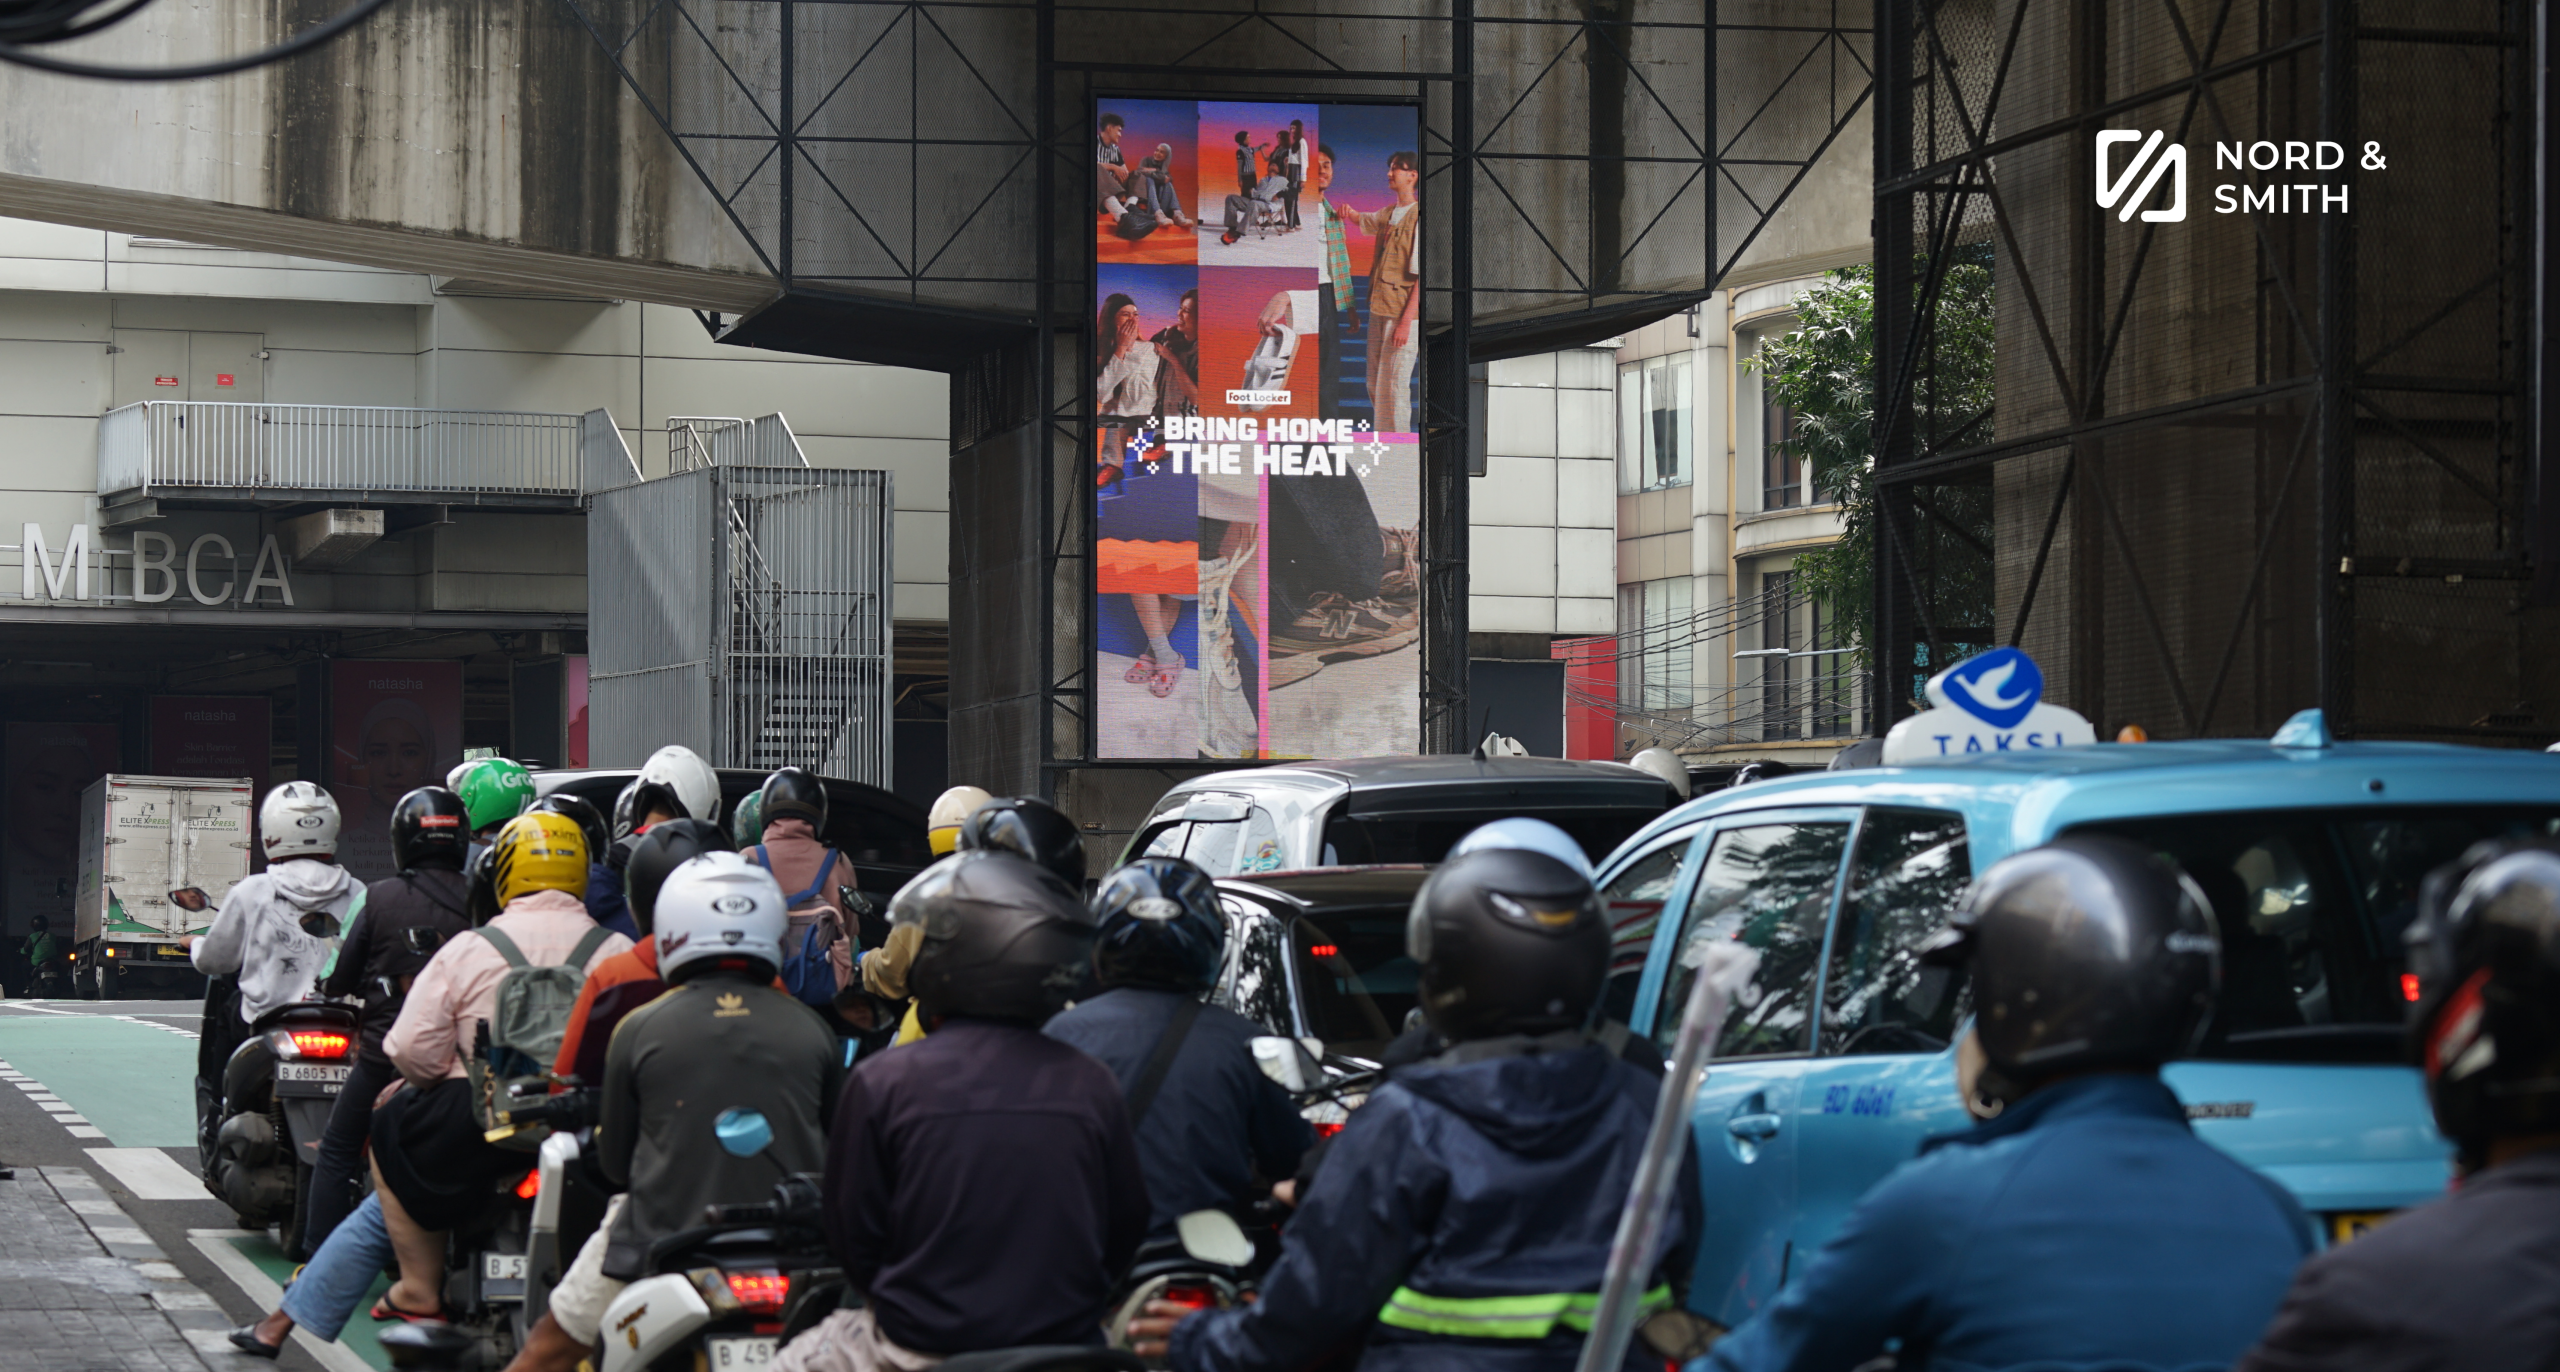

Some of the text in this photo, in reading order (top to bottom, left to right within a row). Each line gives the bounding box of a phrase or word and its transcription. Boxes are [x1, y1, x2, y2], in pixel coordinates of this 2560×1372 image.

[1229, 392, 1288, 403] Foot Locker
[1164, 416, 1354, 442] BRING HOME
[1165, 443, 1354, 476] THE HEAT
[22, 522, 295, 606] M BCA
[368, 677, 424, 690] natasha
[184, 710, 236, 722] natasha
[40, 735, 88, 747] natasha
[184, 742, 236, 752] Skin Barrier
[1932, 733, 2063, 756] TAKSI
[176, 755, 207, 764] adalah
[501, 771, 534, 788] Gra
[144, 815, 170, 825] XPRESS
[210, 818, 236, 827] XPRESS
[524, 828, 578, 841] maxim
[355, 861, 373, 869] kulit
[282, 1067, 290, 1080] B
[294, 1067, 328, 1080] 6805
[491, 1258, 501, 1275] B
[719, 1344, 731, 1366] B
